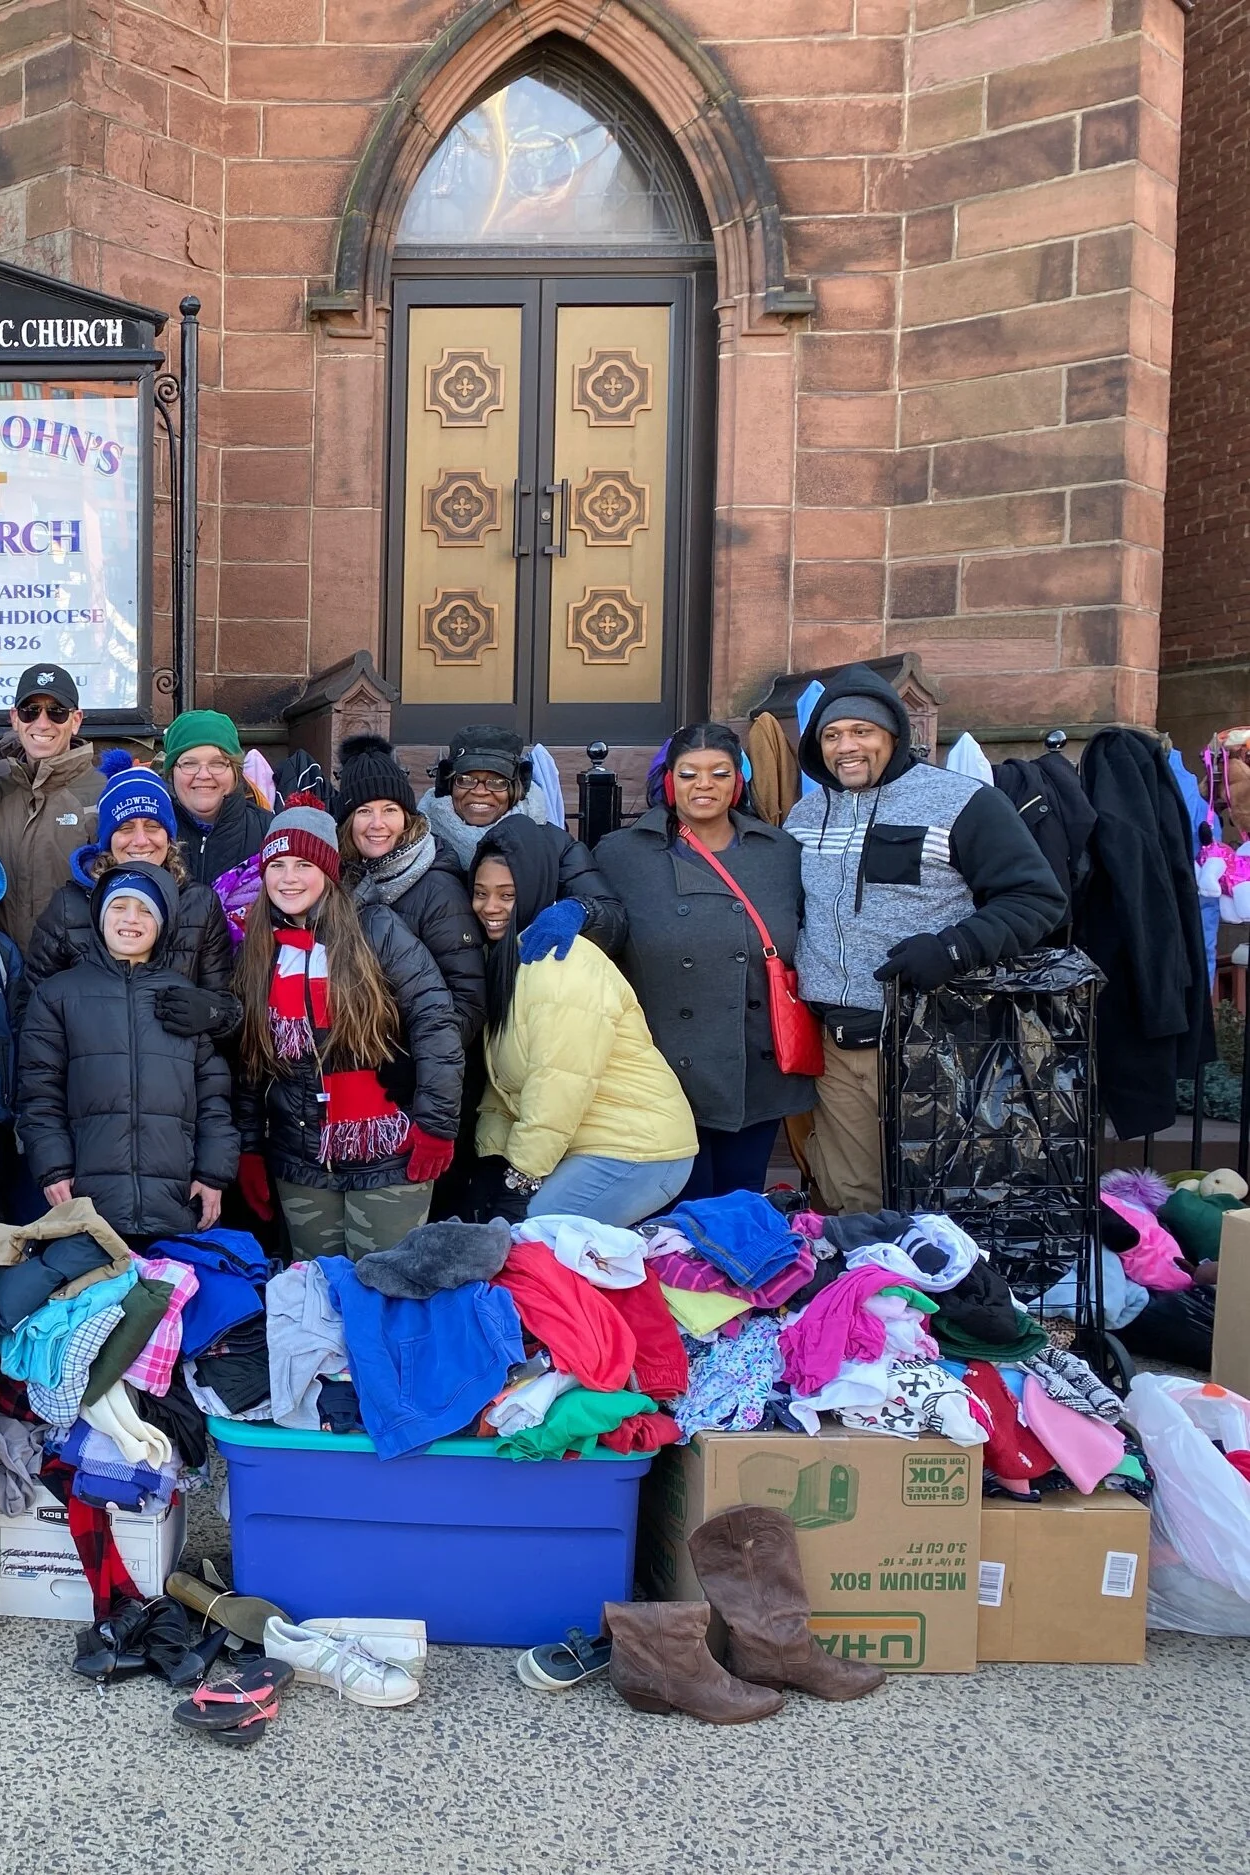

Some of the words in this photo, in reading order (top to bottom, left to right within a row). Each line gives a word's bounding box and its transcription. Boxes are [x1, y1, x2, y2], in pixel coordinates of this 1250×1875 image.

[21, 319, 124, 348] CHURCH
[111, 796, 159, 816] CALDWELL
[115, 805, 158, 821] WRESTLING
[909, 1467, 945, 1483] OK
[41, 1510, 62, 1519] BOX
[907, 1543, 923, 1554] FT
[926, 1543, 944, 1553] CU
[947, 1543, 967, 1553] 3.0
[954, 1558, 966, 1566] 18
[830, 1573, 871, 1590] BOX
[880, 1573, 966, 1590] MEDIUM
[813, 1634, 912, 1658] U-HA
